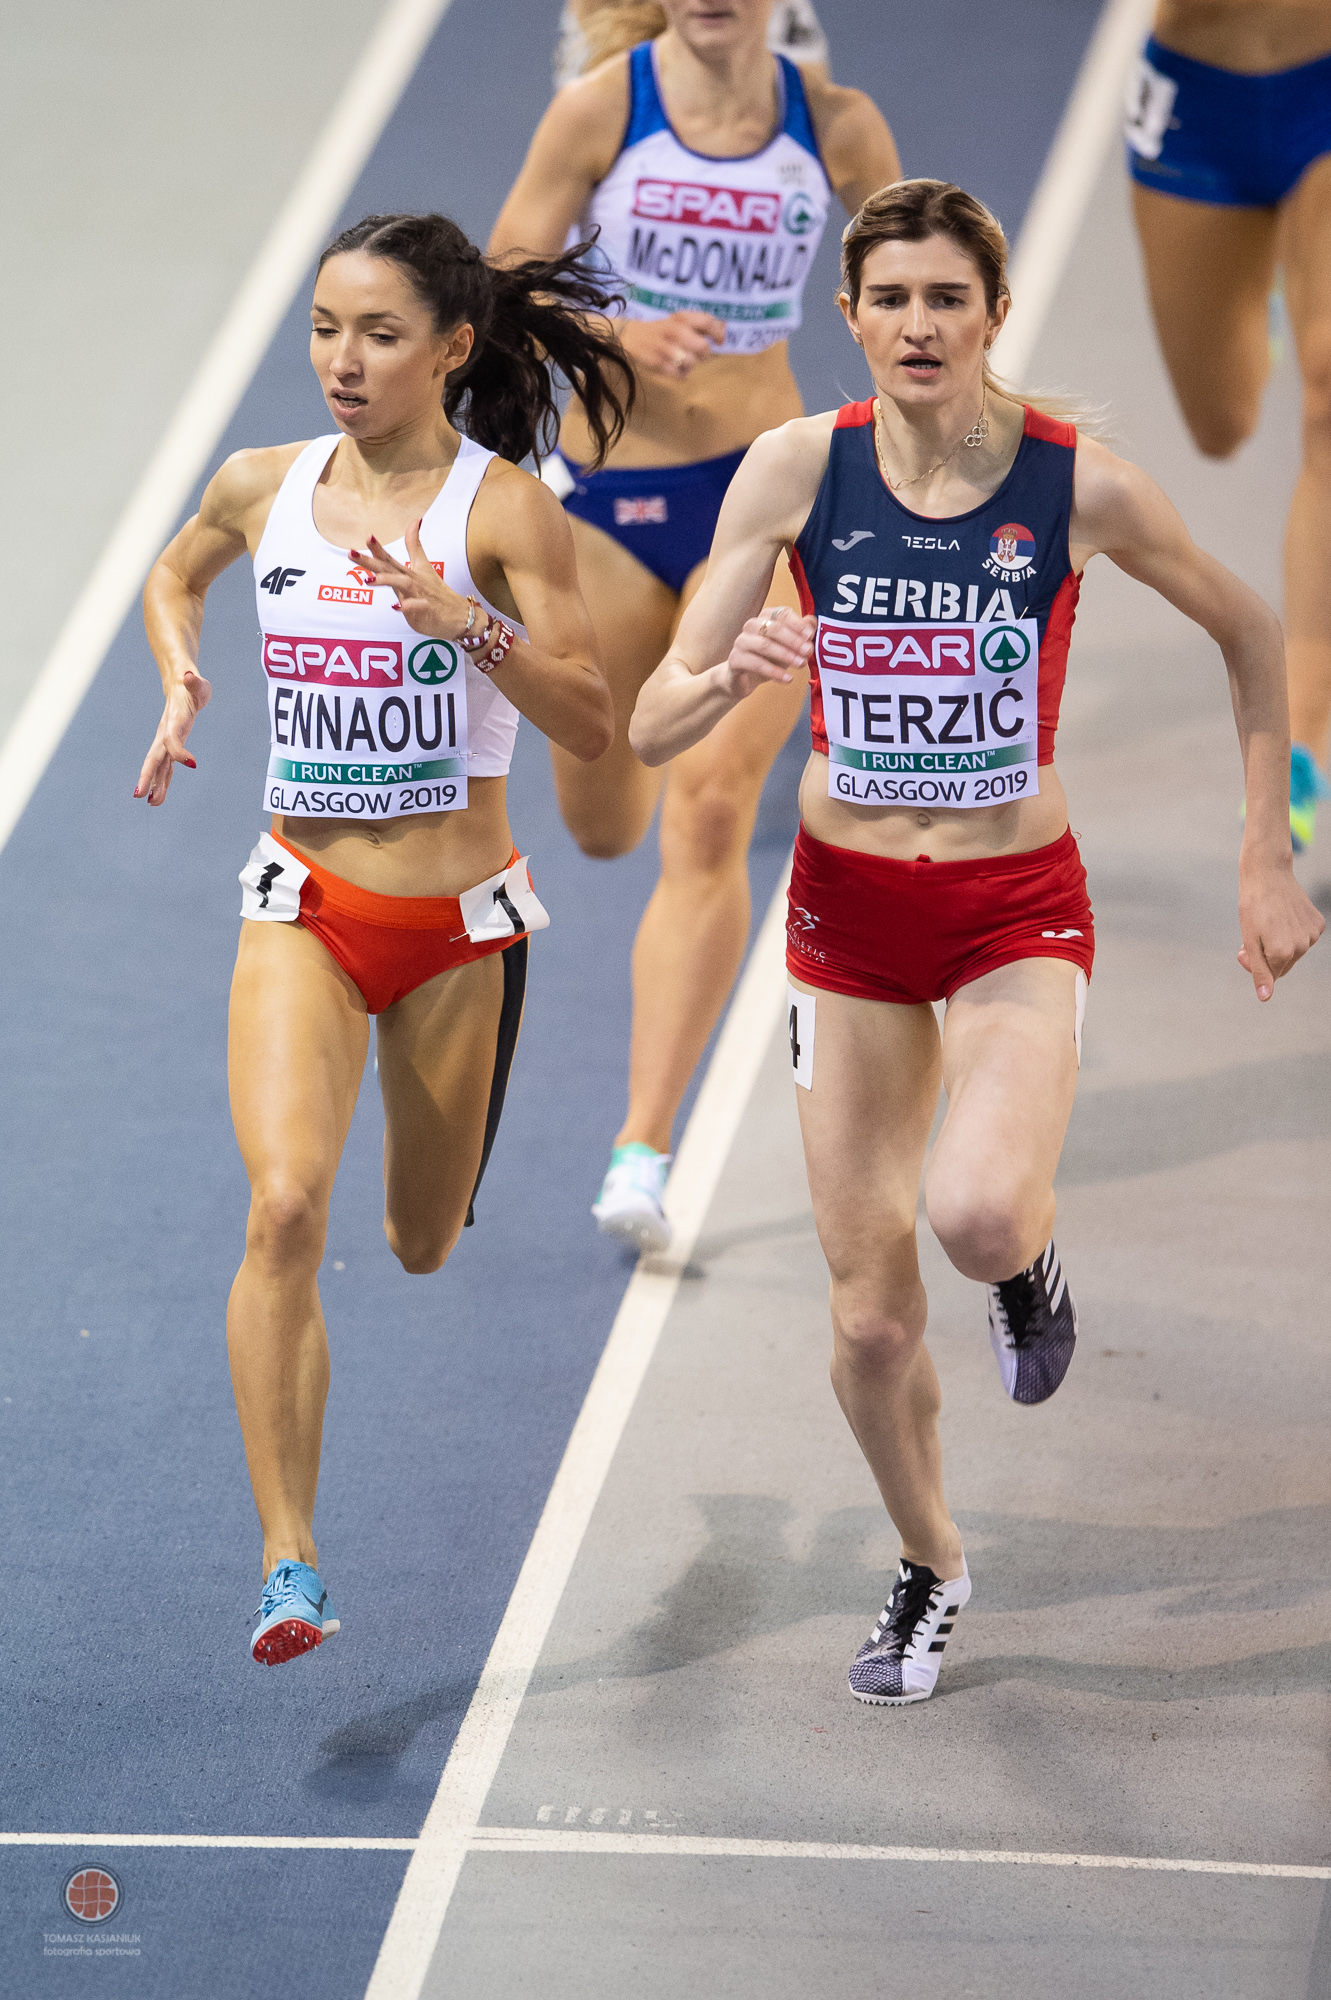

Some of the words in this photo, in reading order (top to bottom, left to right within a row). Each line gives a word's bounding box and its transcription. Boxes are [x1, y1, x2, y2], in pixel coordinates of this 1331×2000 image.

[636, 181, 778, 227] SPAR
[901, 535, 961, 551] TESLA
[260, 566, 307, 595] 4F
[981, 557, 1038, 583] SERBIA
[321, 587, 371, 603] ORLEN
[832, 573, 1018, 623] SERBIA
[267, 640, 399, 681] SPAR
[821, 631, 971, 669] SPAR
[274, 686, 457, 752] ENNAOUI
[831, 677, 1025, 745] TERZIĆ
[292, 763, 296, 779] I
[301, 764, 342, 782] RUN
[862, 752, 867, 768] I
[872, 753, 916, 770] RUN
[270, 787, 392, 814] GLASGOW
[399, 784, 457, 811] 2019
[836, 772, 967, 802] GLASGOW
[974, 770, 1028, 801] 2019
